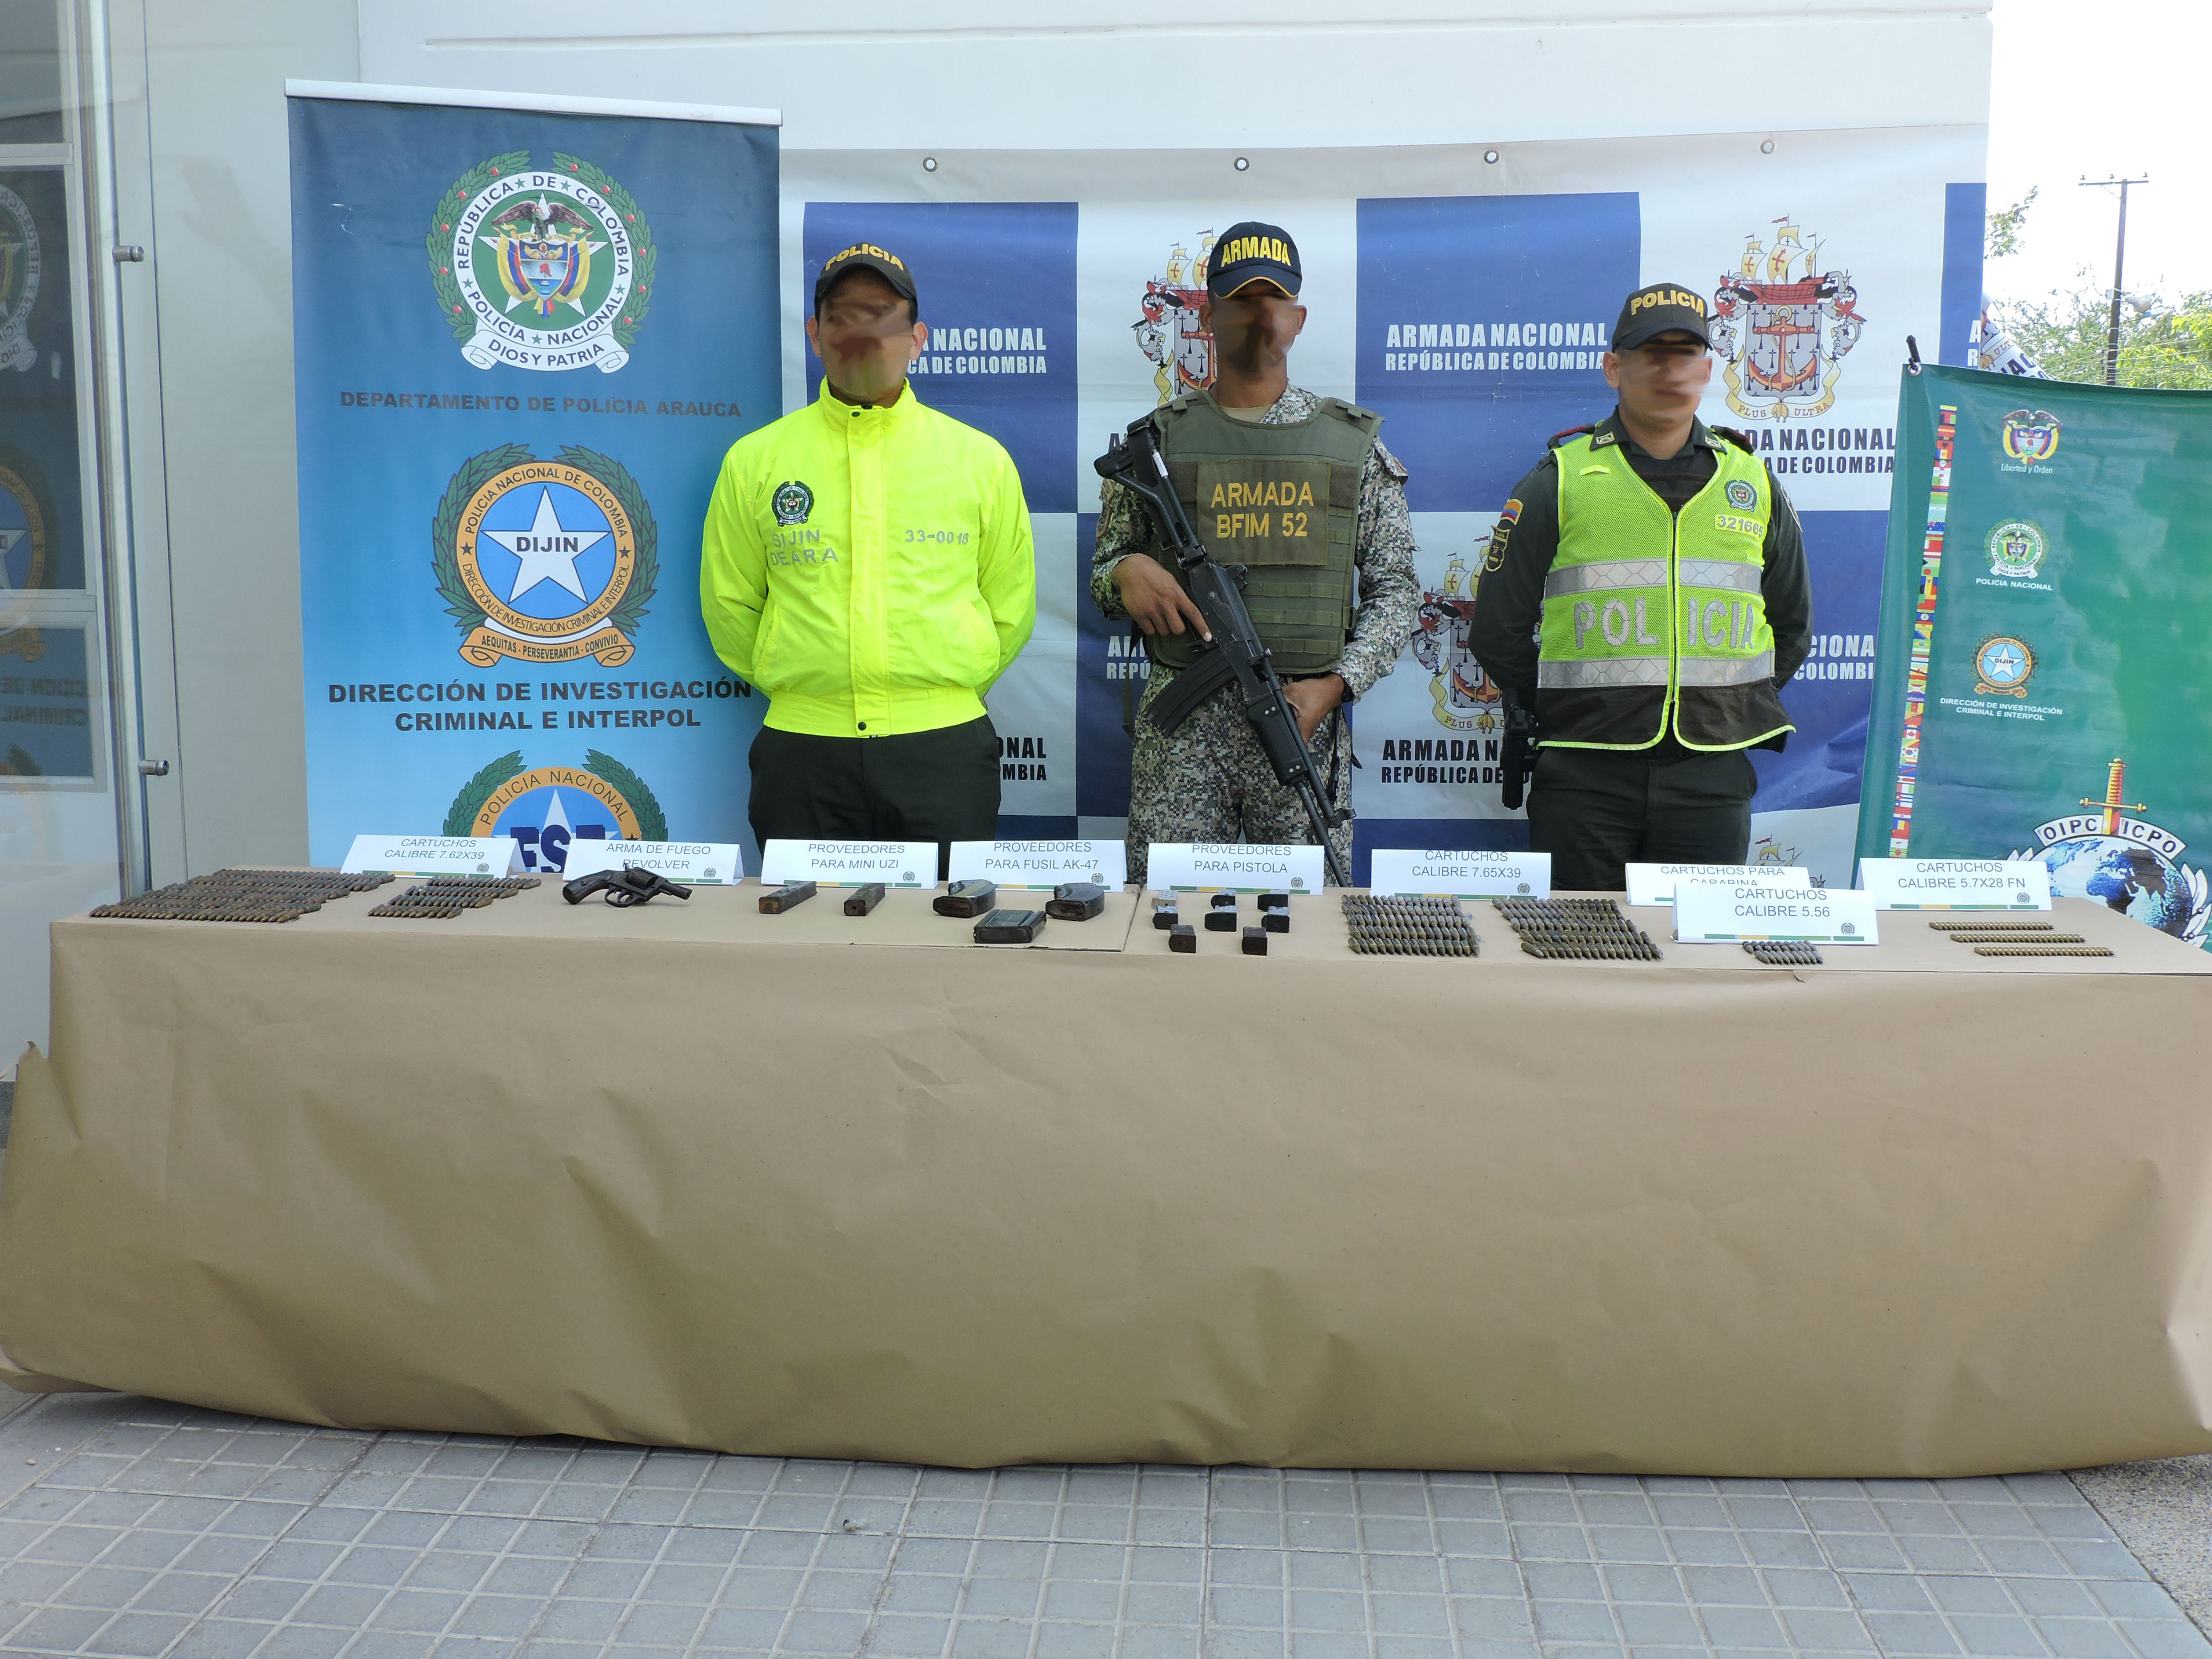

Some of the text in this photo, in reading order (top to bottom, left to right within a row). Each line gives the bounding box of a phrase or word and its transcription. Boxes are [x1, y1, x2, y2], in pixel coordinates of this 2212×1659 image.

[458, 175, 629, 277] REPÚBLICA DE COLOMBIA
[825, 243, 904, 270] POLICIA
[1220, 236, 1292, 268] ARMADA
[1631, 290, 1705, 319] POLICIA
[468, 290, 622, 346] POLICÍA NACIONAL
[933, 328, 1047, 351] NACIONAL
[1386, 322, 1608, 348] ARMADA NACIONAL
[488, 338, 606, 367] DIOS Y PATRIA
[1385, 350, 1605, 371] REPÚBLICA DE COLOMBIA
[932, 357, 952, 374] DE
[956, 356, 1047, 374] COLOMBIA
[341, 392, 520, 413] DEPARTAMENTO
[528, 397, 555, 411] DE
[656, 401, 742, 418] ARAUCA
[1738, 402, 1832, 418] PLUS ULTRA
[1780, 428, 1896, 451] NACIONAL
[1777, 457, 1797, 473] DE
[1802, 456, 1893, 473] COLOMBIA
[2034, 465, 2053, 474] Orden
[465, 467, 628, 538] POLICIA NACIONAL DE COLOMBIA
[1211, 482, 1314, 509] ARMADA
[1216, 512, 1308, 539] BFIM 52
[1716, 515, 1764, 538] 321665
[515, 535, 580, 554] DIJIN
[773, 529, 821, 549] SIJIN
[904, 529, 969, 546] 33-0018
[769, 547, 839, 567] DEARA
[1975, 578, 2053, 591] POLICIA NACIONAL
[462, 563, 494, 611] DIRECCIÓN
[490, 605, 503, 619] DE
[502, 611, 566, 633] INVESTIGACIÓN
[565, 607, 605, 633] CRIMINAL
[604, 564, 630, 607] INTERPOL
[481, 634, 619, 659] AEQUITAS PERSEVERANTIA CONVIVIO
[1794, 662, 1874, 680] COLOMBI
[328, 677, 752, 703] DIRECCIÓN DE INVESTIGACIÓN
[1940, 697, 1985, 708] DIRECCIÓN
[1999, 703, 2063, 715] INVESTIGACIÓN
[1956, 707, 1995, 716] CRIMINAL
[2004, 711, 2044, 721] INTERPOL
[395, 709, 701, 732] CRIMINAL E INTERPOL
[1444, 715, 1473, 729] PLUS
[1383, 739, 1480, 761] ARMADA
[1003, 764, 1046, 781] MBIA
[1381, 763, 1478, 784] REPÚBLICA
[1483, 767, 1503, 784] DE
[480, 771, 628, 826] POLICIA NACIONAL
[400, 838, 477, 848] CARTUCHOS
[2045, 818, 2177, 853] OIPC ICPO
[384, 850, 485, 860] CALIBRE 7.62X39
[606, 843, 711, 855] ARMA DE FUEGO
[808, 843, 905, 854] PROVEEDORES
[994, 842, 1092, 853] PROVEEDORES
[1192, 844, 1291, 855] PROVEEDORES
[1425, 850, 1508, 862] CARTUCHOS
[622, 859, 690, 869] REVOLVER
[811, 858, 899, 869] PARA MINI UZI
[985, 858, 1099, 870] PARA FUSIL AK-47
[1194, 860, 1288, 873] PARA PISTOLA
[1411, 866, 1522, 878] CALIBRE 7.65X39
[1661, 866, 1785, 875] CARTUCHOS PARA
[1917, 862, 2003, 873] CARTUCHOS
[1898, 878, 2025, 889] CALIBRE 5.7X28 FN
[1735, 888, 1827, 901] CARTUCHOS
[1735, 904, 1830, 918] CALIBRE 5.56
